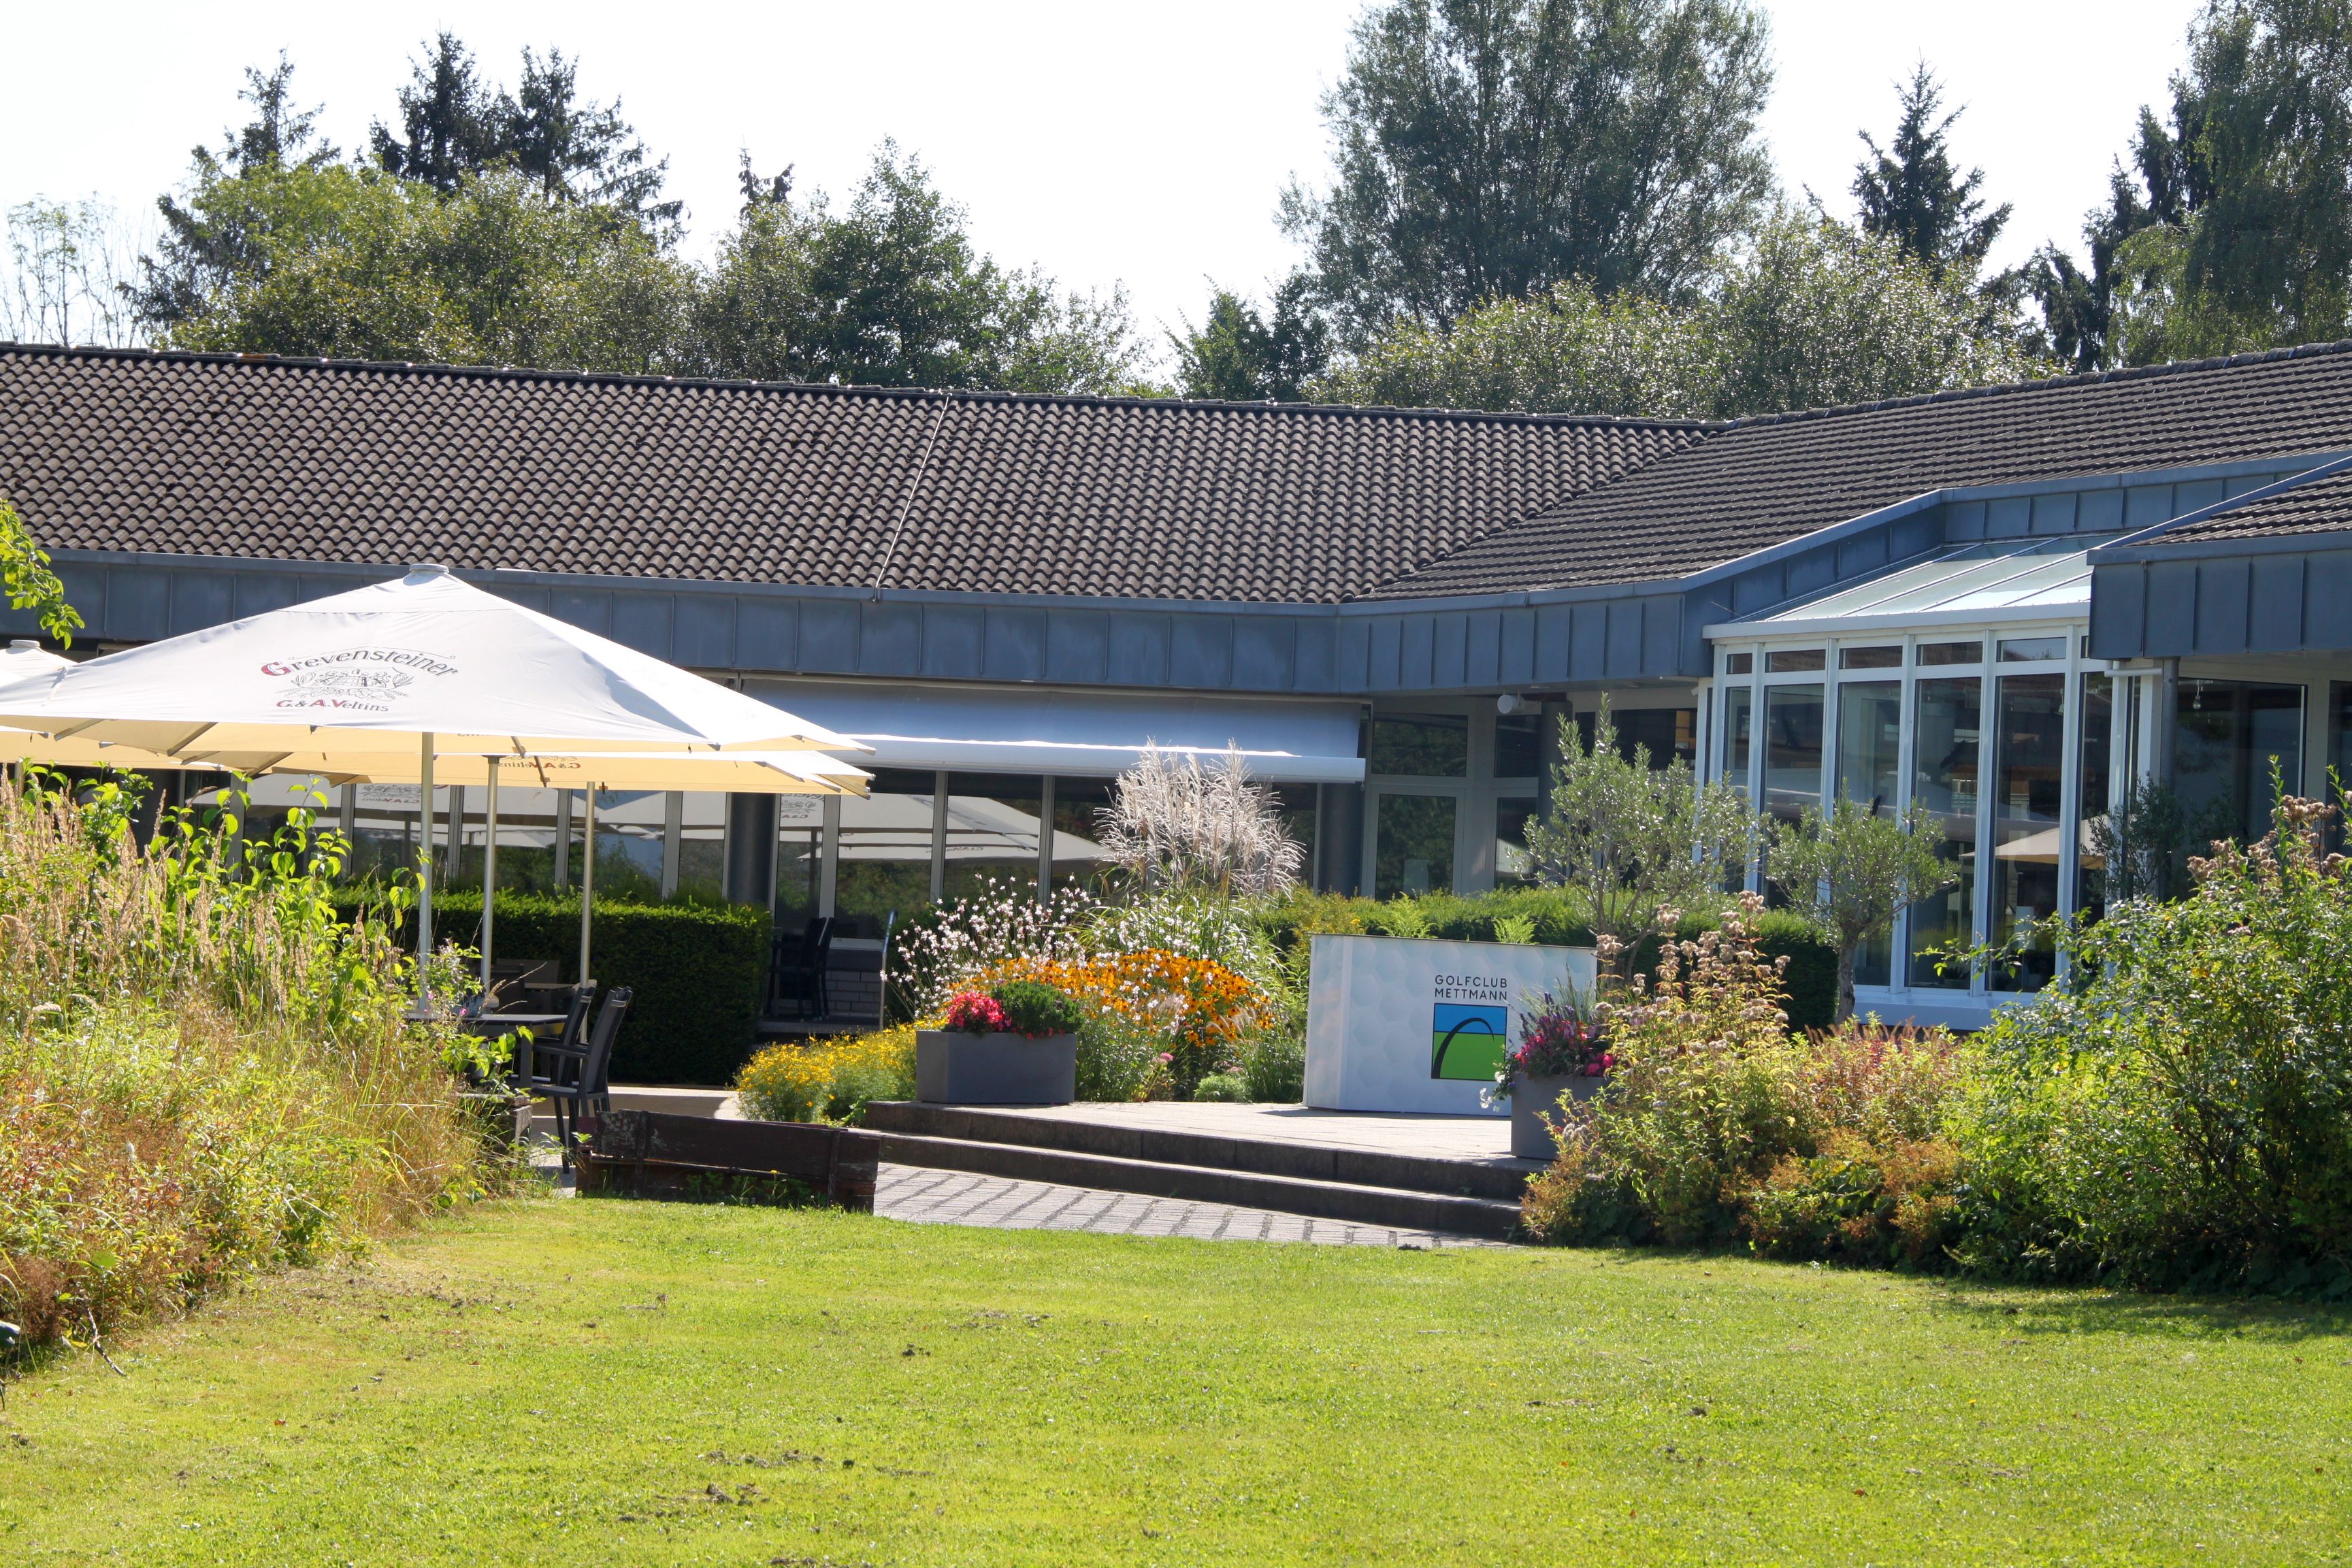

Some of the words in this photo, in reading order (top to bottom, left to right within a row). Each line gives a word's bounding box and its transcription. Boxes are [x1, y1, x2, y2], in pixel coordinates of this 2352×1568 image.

[261, 649, 459, 677] Grevensteiner
[1435, 975, 1507, 988] GOLFCLUB
[1434, 987, 1507, 1000] METTMANN
